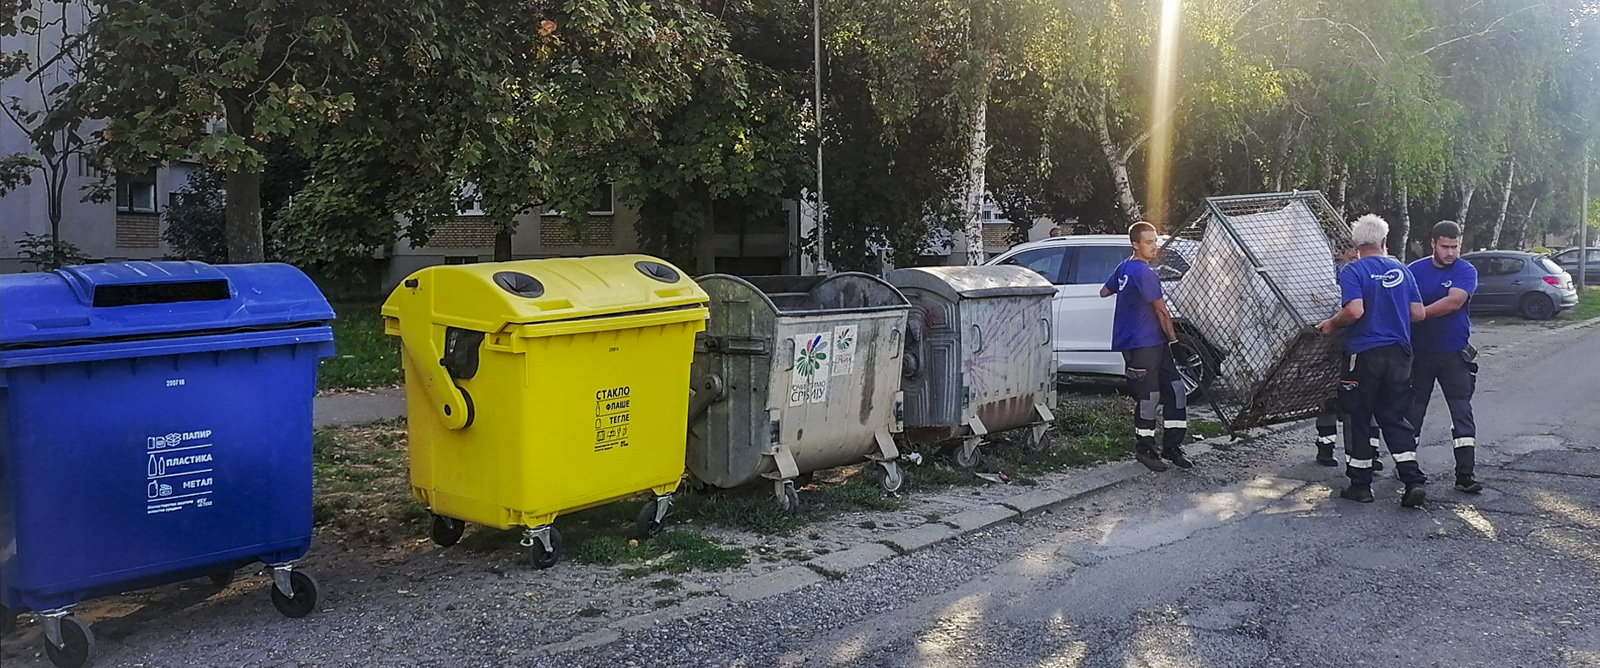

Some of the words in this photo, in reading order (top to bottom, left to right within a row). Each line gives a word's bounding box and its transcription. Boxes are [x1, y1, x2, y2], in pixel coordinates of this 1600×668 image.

[596, 386, 630, 400] СТАКЛО
[791, 387, 826, 402] СРБИЈУ
[606, 400, 630, 411] ФЛАШЕ
[609, 413, 630, 425] ТЕГЛЕ
[182, 429, 212, 441] ПАПИР
[166, 453, 213, 467] ПЛАСТИКА
[183, 478, 213, 489] МЕТАЛ
